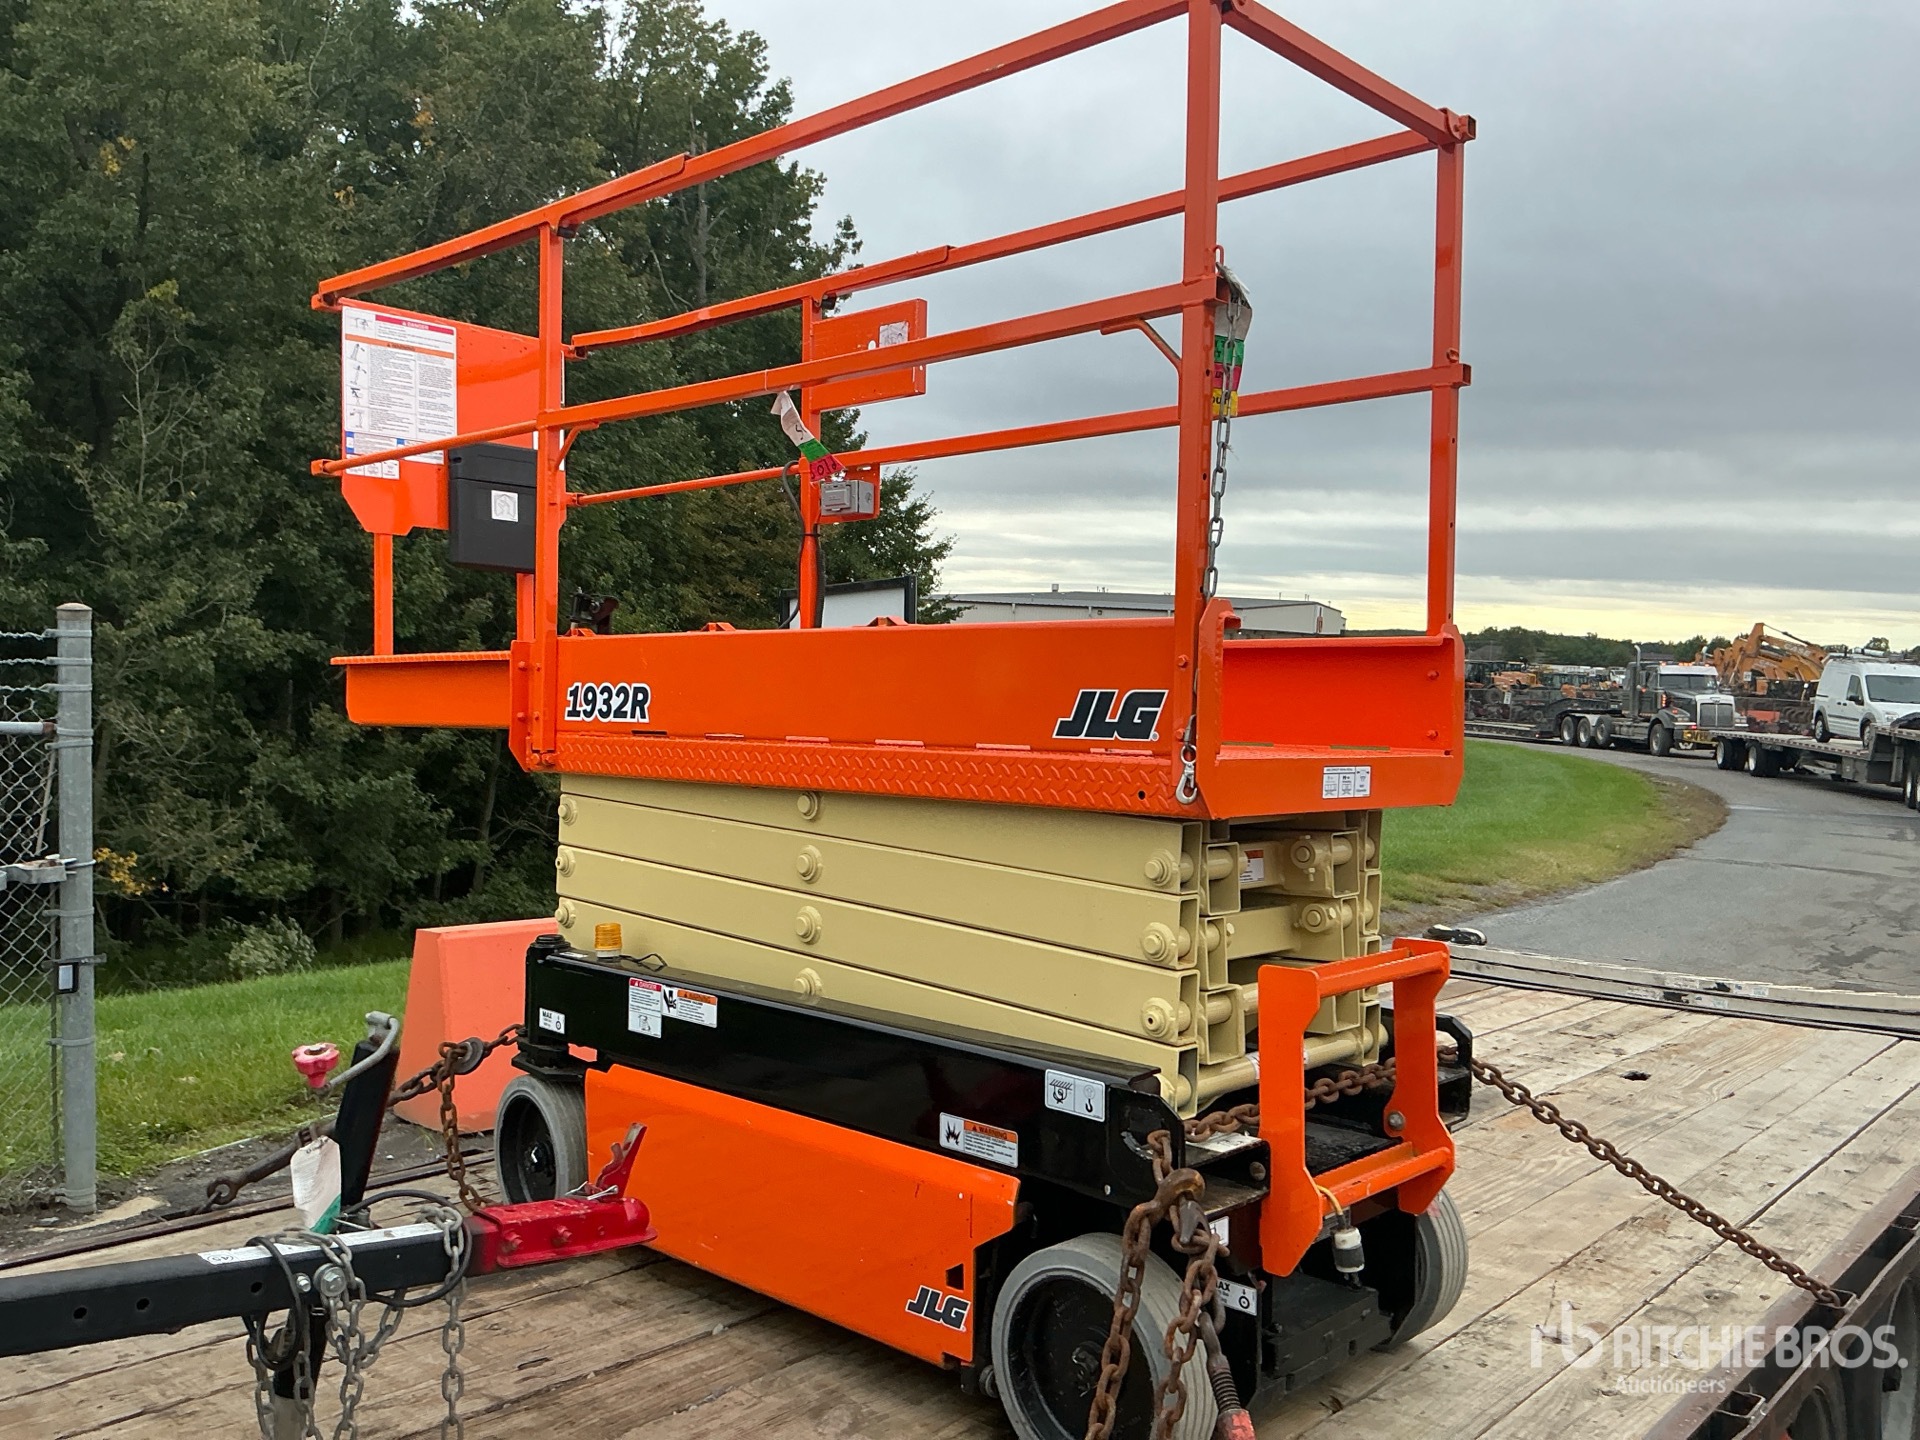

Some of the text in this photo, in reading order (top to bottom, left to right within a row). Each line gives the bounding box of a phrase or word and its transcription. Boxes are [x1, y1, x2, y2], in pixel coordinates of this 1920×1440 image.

[565, 684, 649, 720] 1932R
[1053, 690, 1167, 740] JLG
[979, 1125, 1008, 1140] WARNING
[906, 1285, 970, 1330] JLG
